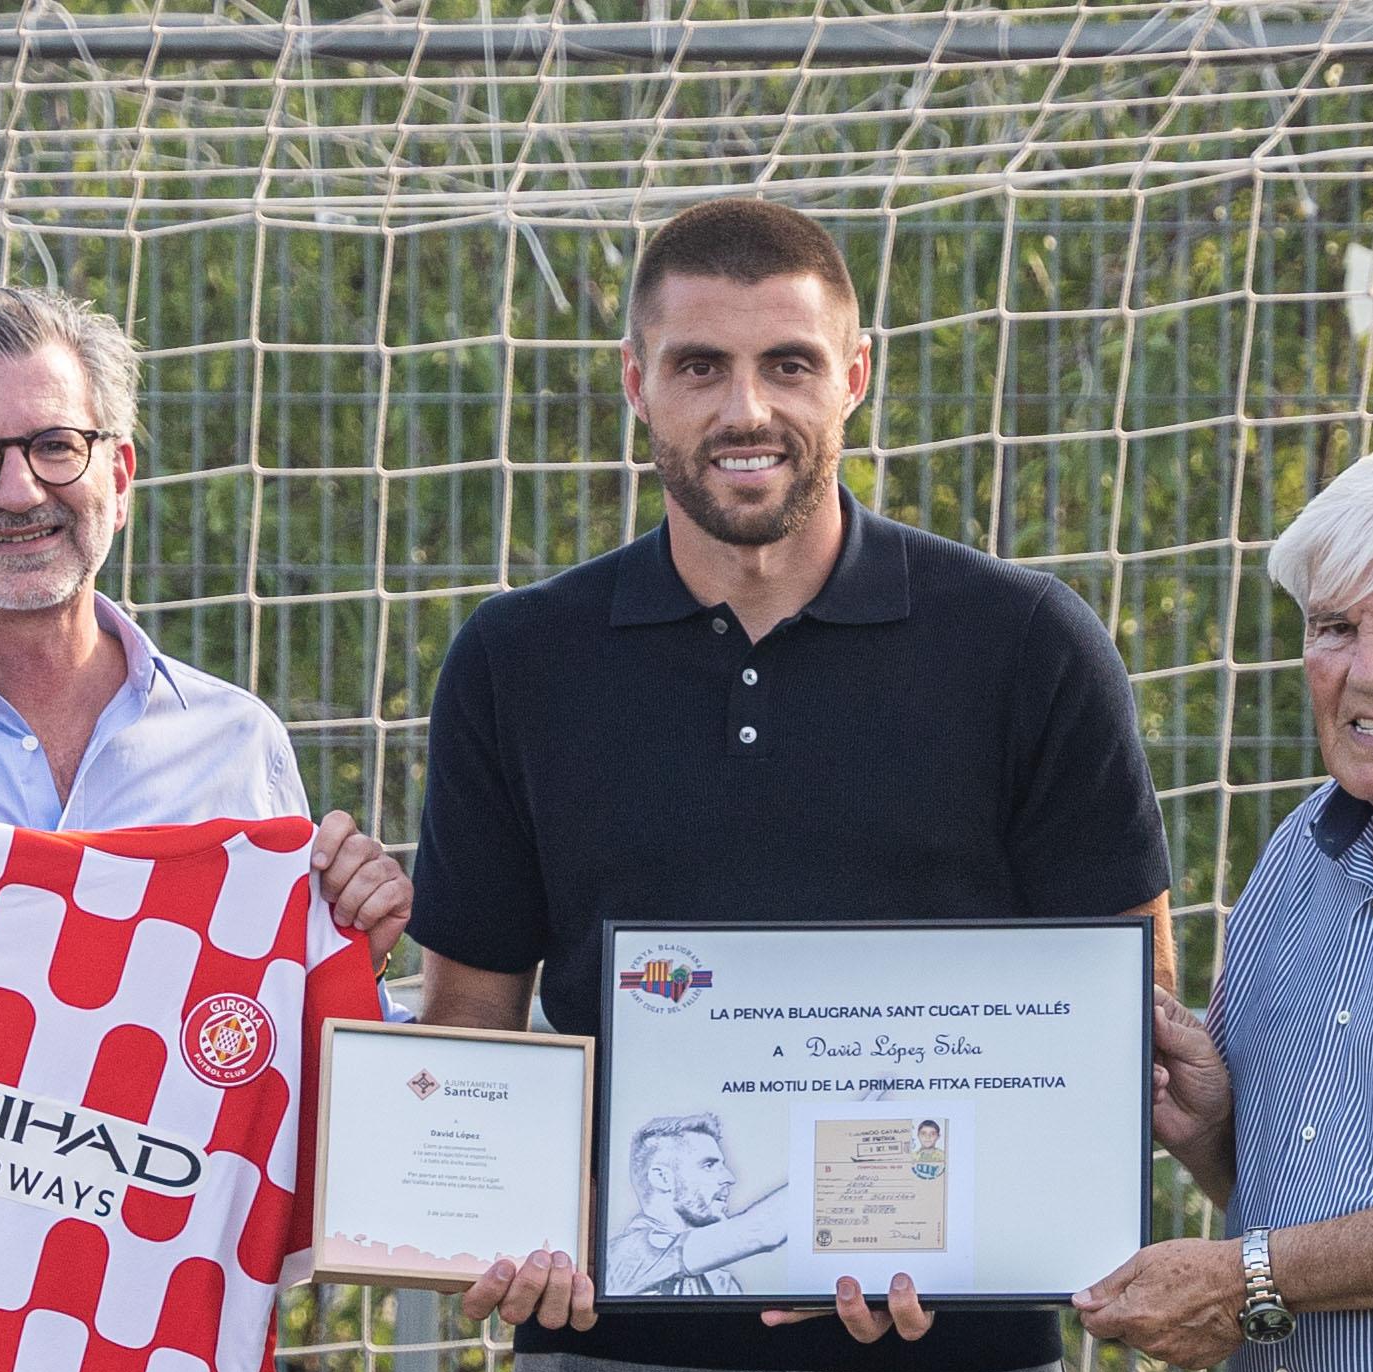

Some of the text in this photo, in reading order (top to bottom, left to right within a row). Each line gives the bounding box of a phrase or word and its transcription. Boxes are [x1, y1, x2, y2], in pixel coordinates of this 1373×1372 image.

[630, 944, 702, 970] PENYA BLAUGRANA
[209, 998, 264, 1029] GIRONA
[643, 1002, 665, 1014] CUGAT
[667, 1005, 681, 1014] DEL
[710, 1001, 1070, 1020] LA PENYA BLAUGRANA SANT CUGAT DEL VALLÉS
[772, 1034, 983, 1064] A David López Silva
[194, 1052, 247, 1079] FUTBOL CLUB
[444, 1079, 508, 1090] AJUNTAMENT DE
[722, 1076, 1066, 1093] AMB MOTIU DE LA PRIMERA FITXA FEDERATIVA
[444, 1087, 509, 1101] SantCugat
[430, 1129, 480, 1140] David López
